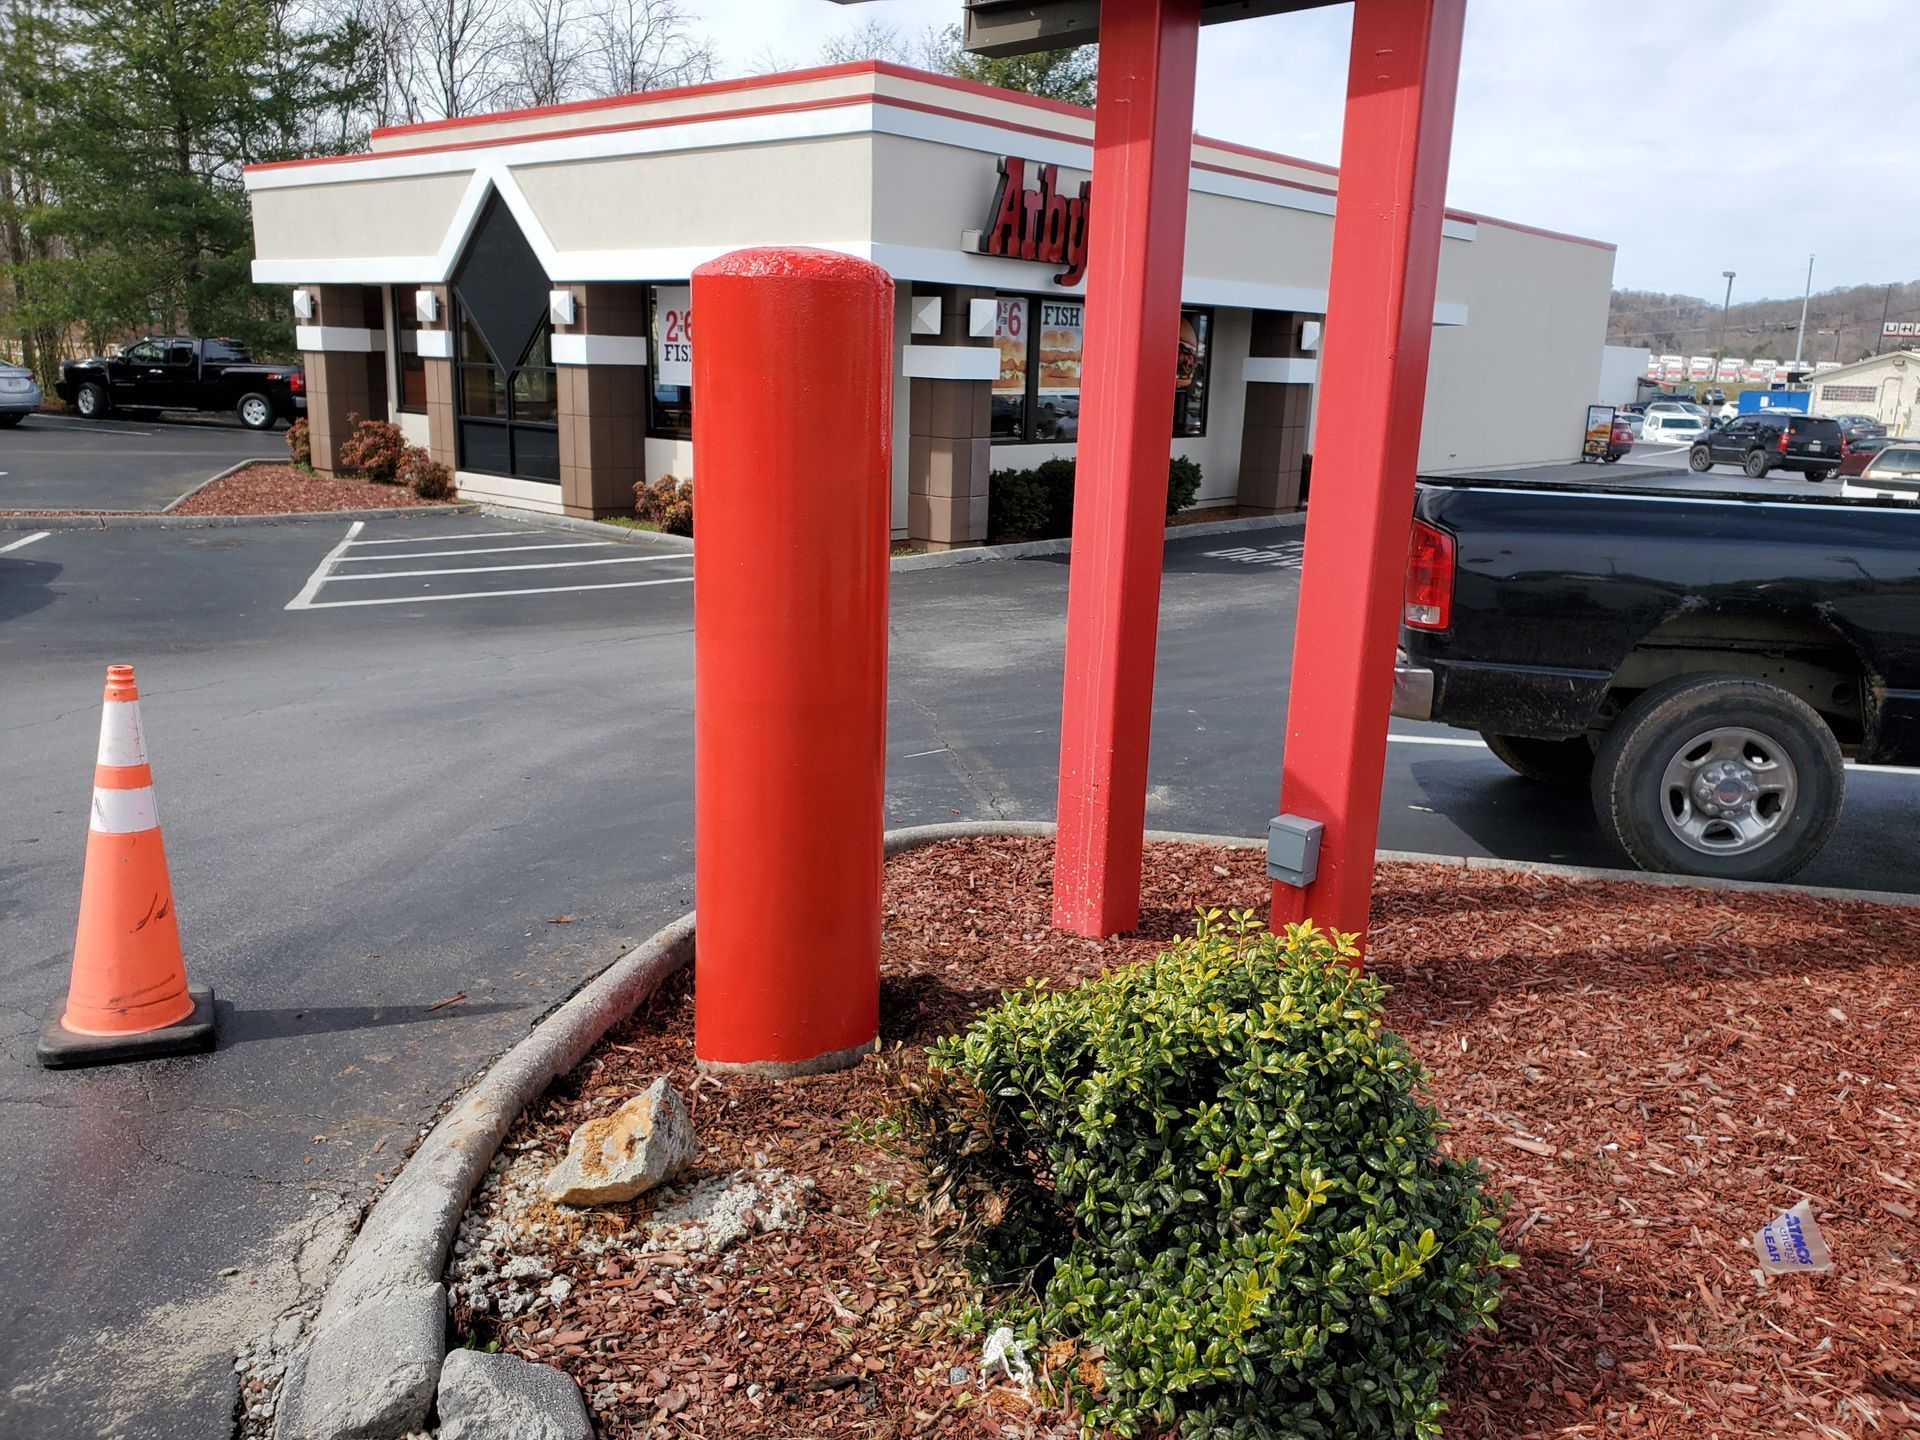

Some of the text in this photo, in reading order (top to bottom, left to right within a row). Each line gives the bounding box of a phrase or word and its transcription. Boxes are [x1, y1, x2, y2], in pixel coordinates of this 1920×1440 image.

[985, 155, 1091, 287] Arby
[1043, 305, 1081, 327] FISH
[1886, 324, 1920, 333] U-H
[664, 343, 692, 362] FIS
[1763, 1223, 1782, 1262] LEAR
